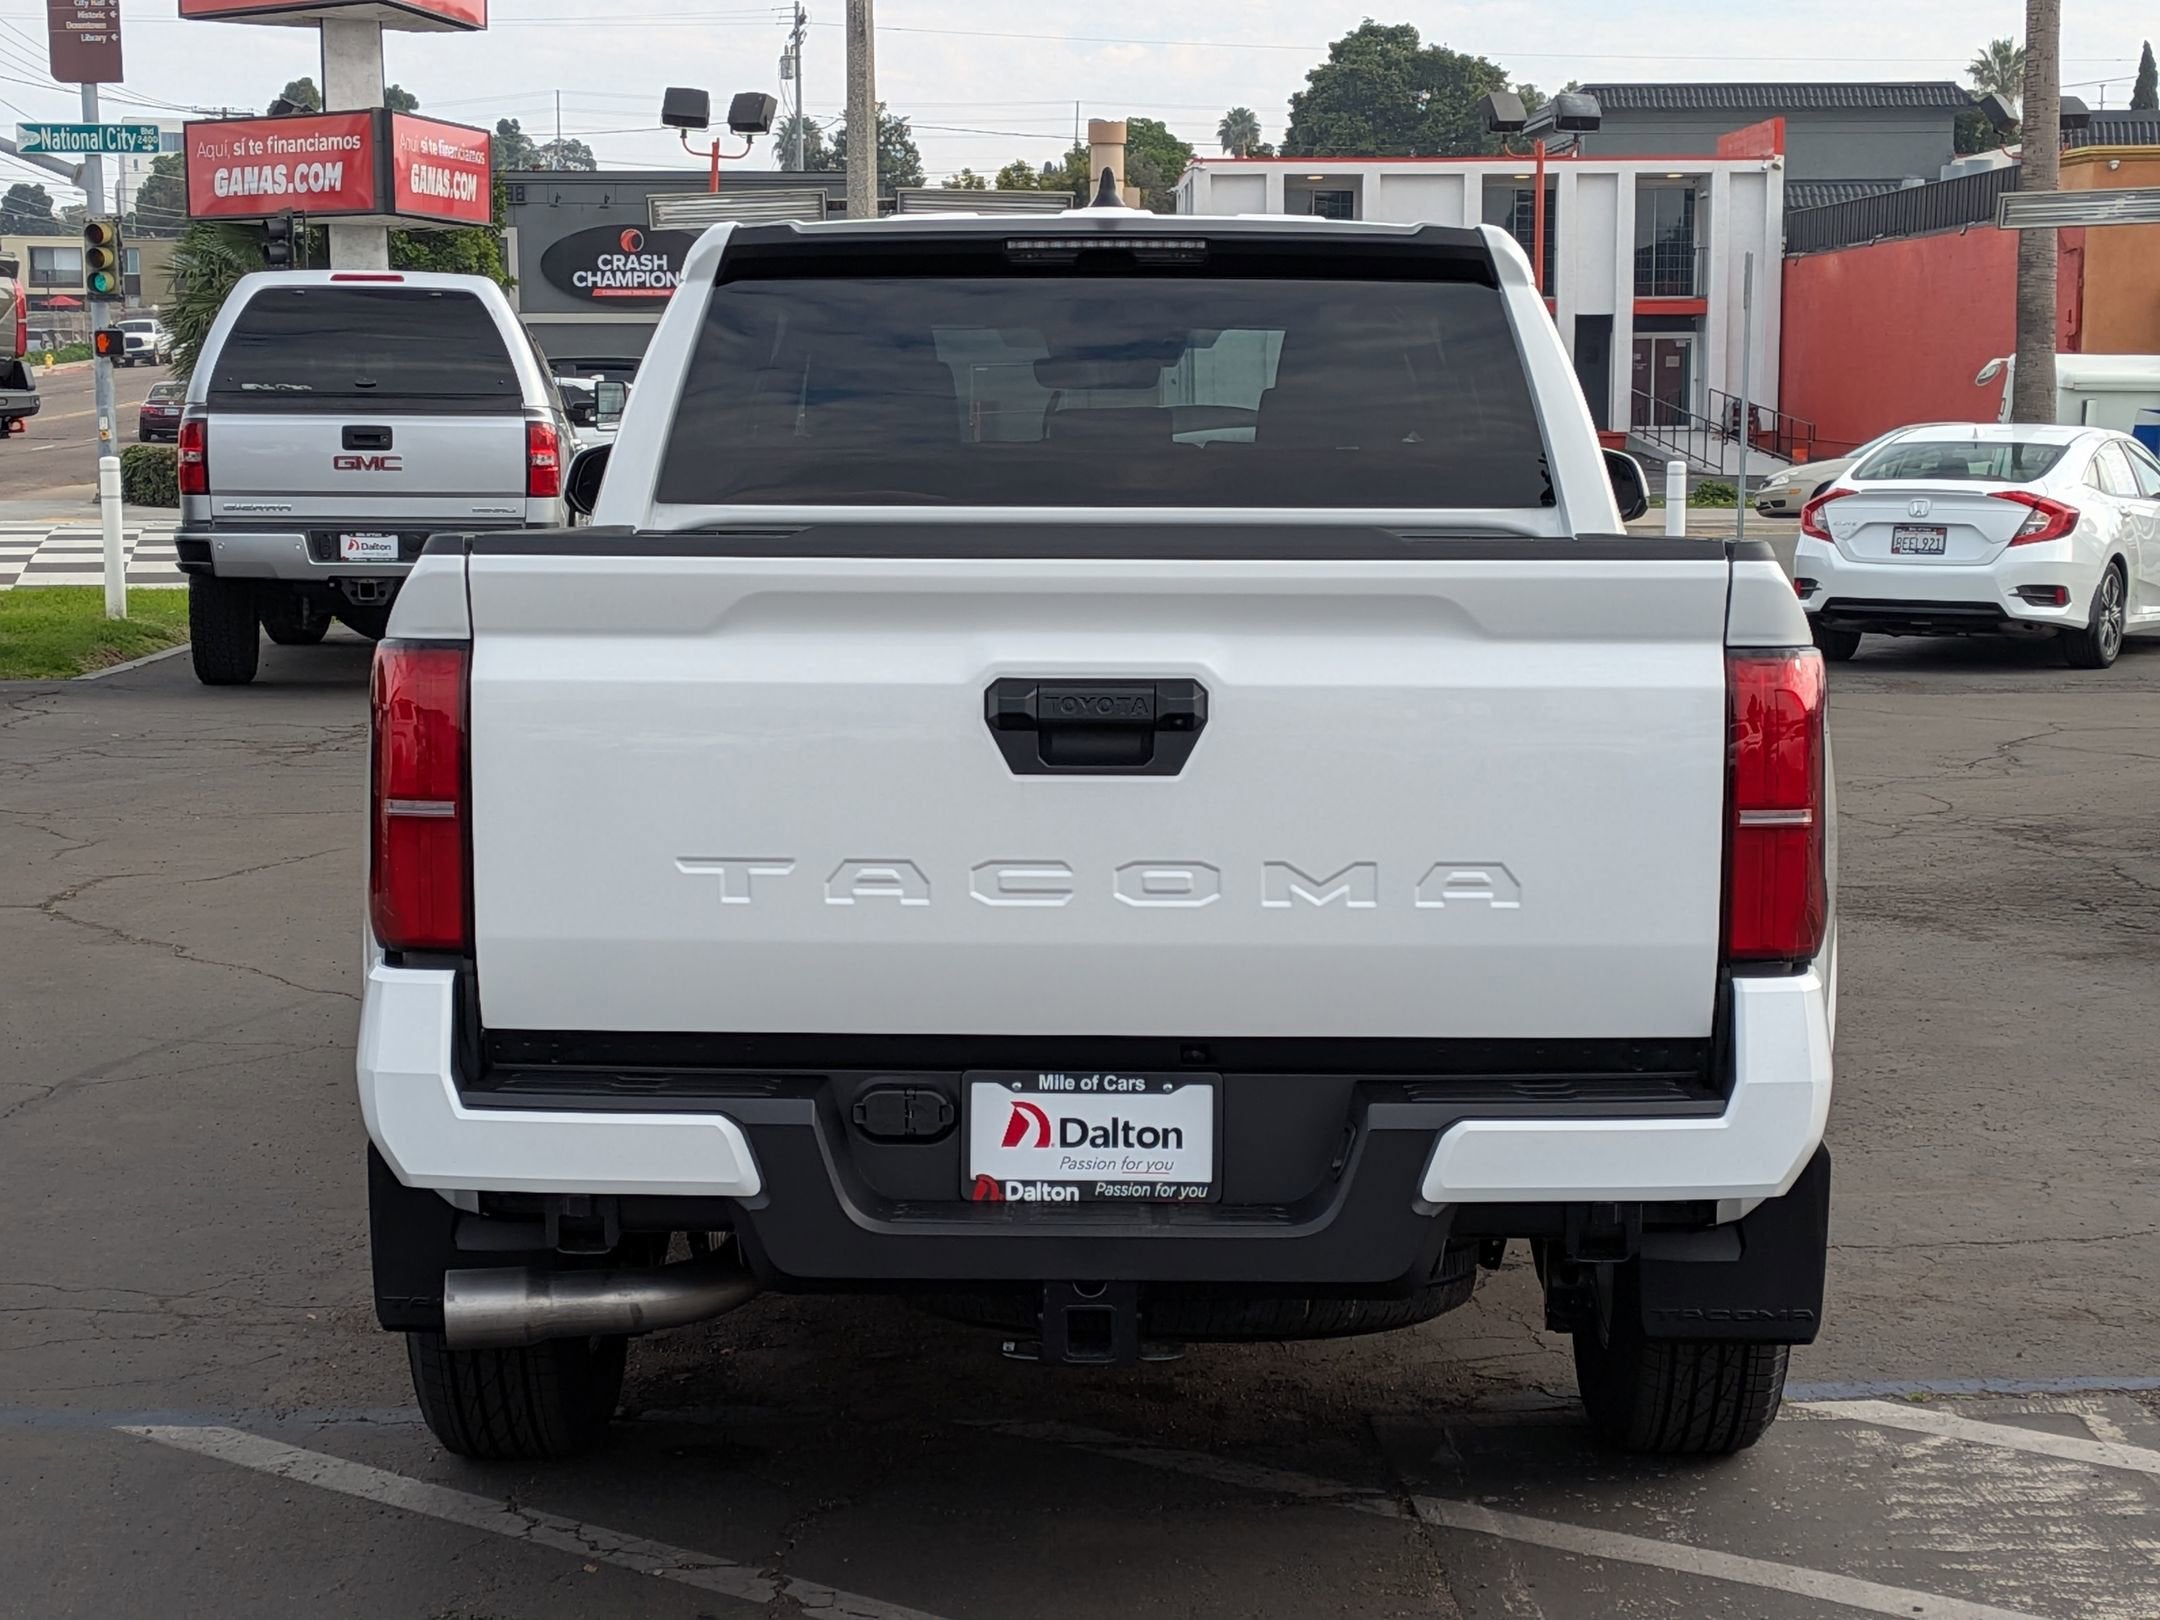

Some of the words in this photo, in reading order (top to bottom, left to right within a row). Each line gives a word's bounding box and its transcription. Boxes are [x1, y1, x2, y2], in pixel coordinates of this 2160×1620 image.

[77, 10, 106, 19] Historic
[66, 21, 107, 29] Downtown
[80, 33, 107, 44] Library
[41, 126, 104, 150] National
[106, 126, 137, 152] City
[137, 135, 159, 145] 2400
[196, 139, 231, 161] Aquí,
[233, 137, 247, 156] sí
[248, 140, 264, 155] te
[266, 132, 361, 155] financiamos
[214, 161, 343, 198] GANAS.COM
[411, 163, 478, 202] GANAS.COM
[597, 254, 667, 271] CRASH
[572, 271, 680, 287] CHAMPION
[333, 455, 403, 472] GMC
[361, 542, 391, 551] Dalton
[1044, 695, 1149, 717] TOYOTA
[675, 854, 1523, 909] TACOMA
[1038, 1074, 1075, 1091] Mile
[1080, 1075, 1099, 1091] of
[1103, 1075, 1146, 1092] Cars
[1059, 1117, 1183, 1150] Dalton
[1059, 1156, 1116, 1171] Passion
[1120, 1157, 1143, 1173] for
[1145, 1160, 1174, 1173] you
[1005, 1181, 1080, 1202] Dalton
[1095, 1182, 1153, 1198] Passion
[1154, 1183, 1179, 1199] for
[1179, 1185, 1208, 1200] you
